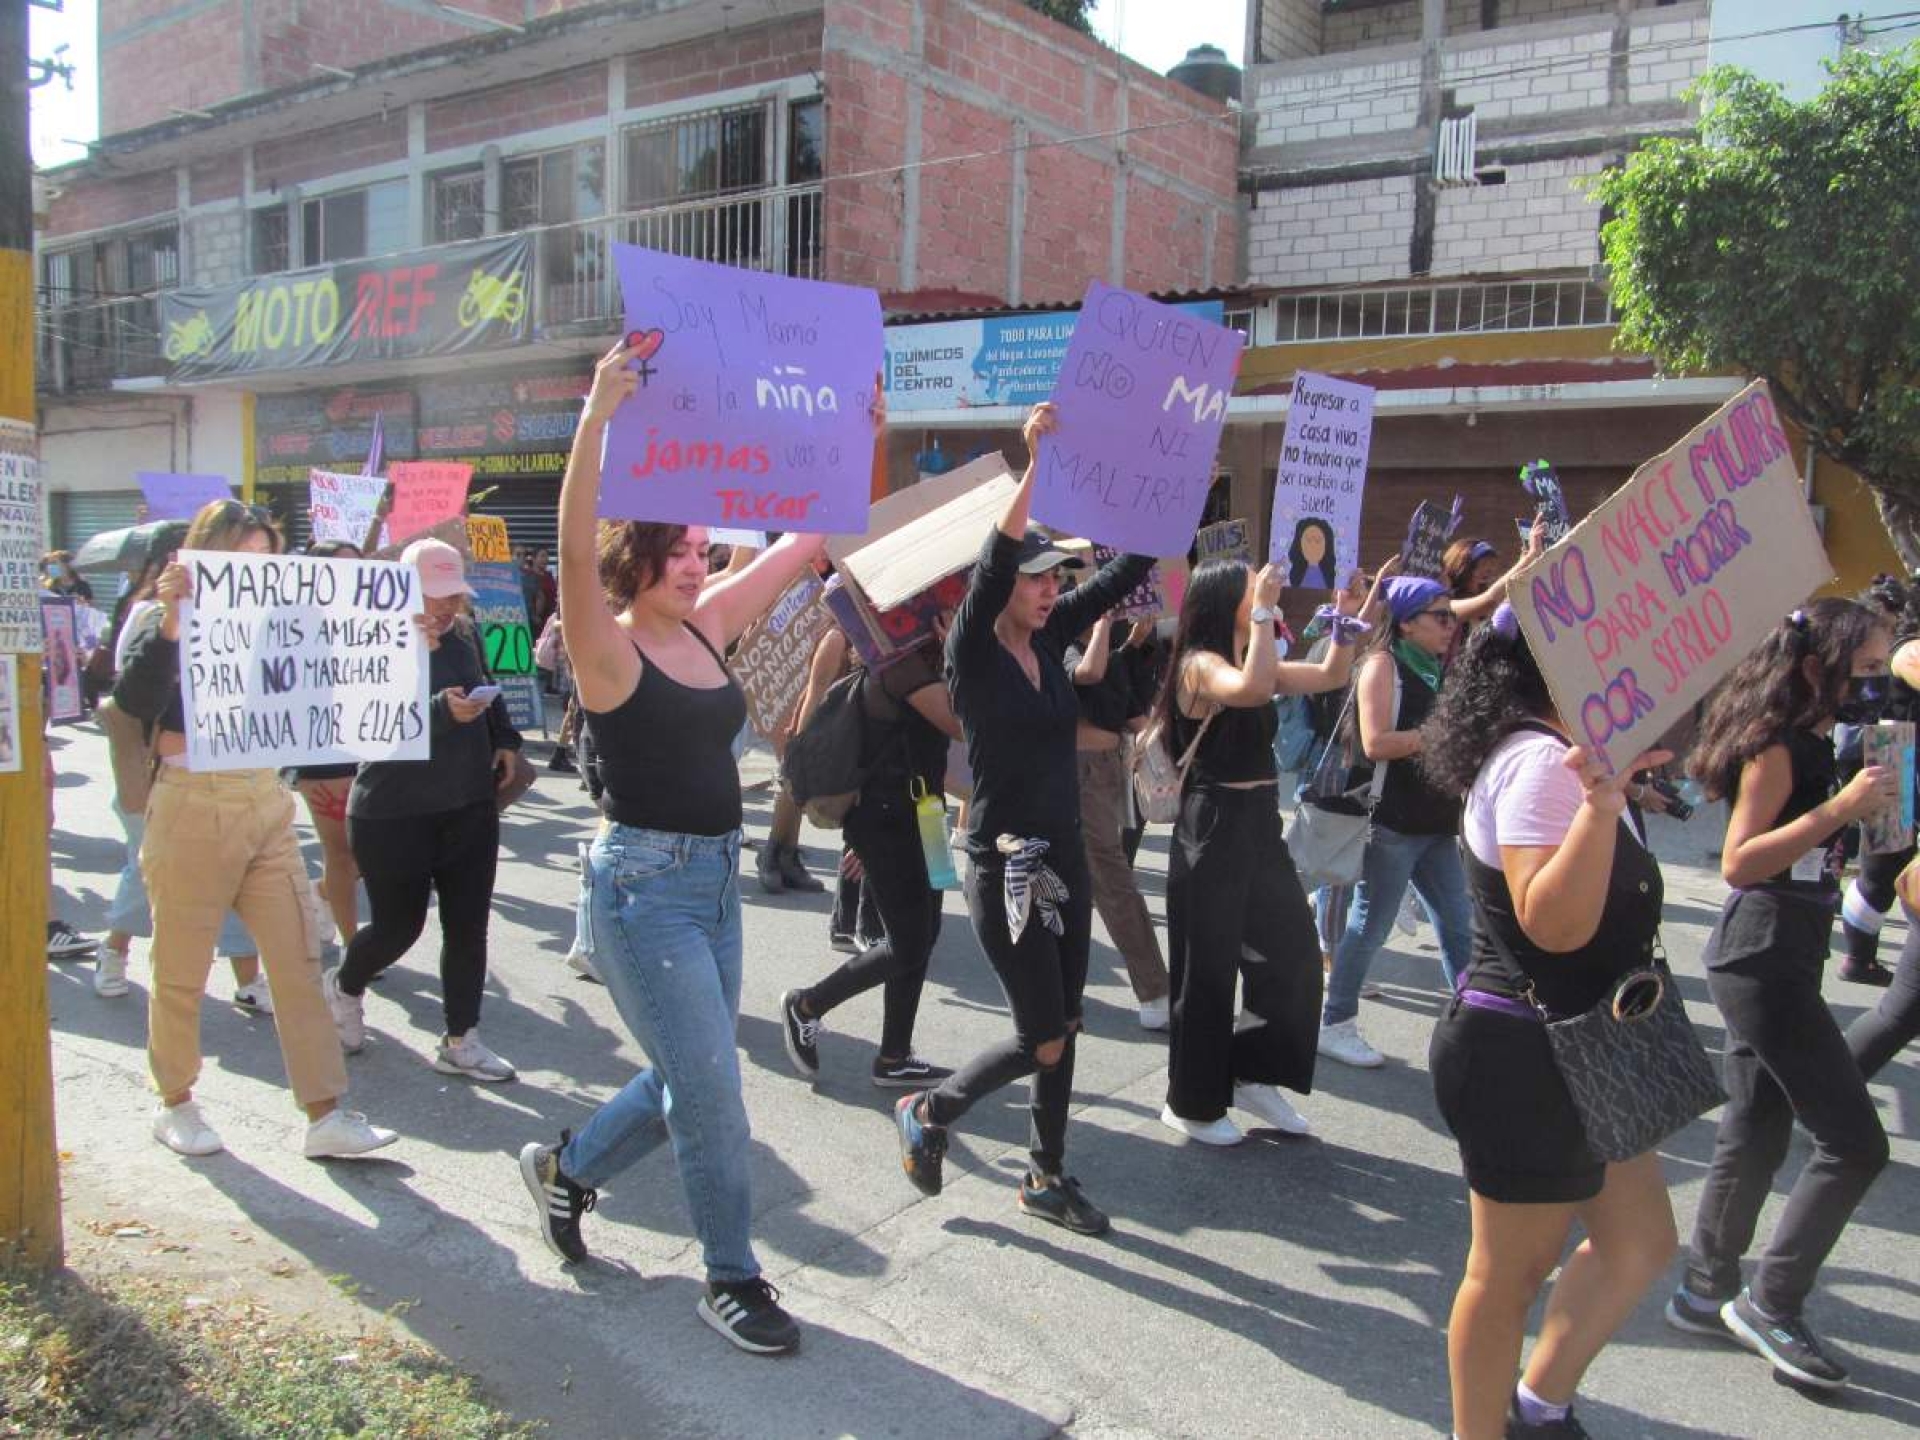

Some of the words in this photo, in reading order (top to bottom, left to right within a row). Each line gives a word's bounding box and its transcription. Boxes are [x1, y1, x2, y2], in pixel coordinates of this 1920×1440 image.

[231, 277, 340, 353] MOTO
[351, 262, 439, 341] REF
[1099, 291, 1220, 368] QUIEN
[999, 328, 1025, 344] TODO
[672, 387, 695, 412] de
[756, 366, 838, 416] niña
[894, 364, 923, 377] DEL
[894, 375, 953, 391] CENTRO
[1349, 398, 1359, 412] a
[630, 427, 771, 480] jamas
[1300, 423, 1331, 443] casa
[1284, 445, 1300, 463] no
[1345, 455, 1363, 475] que
[1531, 544, 1597, 644] NO
[1599, 460, 1692, 578] NACI
[1688, 391, 1791, 504] MUJER
[194, 560, 336, 609] MARCHO
[353, 566, 411, 612] HOY
[208, 618, 251, 655] CON
[267, 617, 305, 648] MIS
[317, 616, 391, 647] AMIGAS
[484, 623, 532, 675] 20
[1584, 579, 1668, 684] PARA
[189, 663, 245, 703] PARA
[260, 655, 297, 695] NO
[303, 655, 390, 689] MARCHAR
[732, 635, 773, 682] NOS
[1580, 666, 1656, 777] POR
[1652, 587, 1733, 695] SERLO
[193, 705, 297, 758] MAÑANA
[307, 702, 346, 751] POR
[358, 699, 424, 744] ELLAS
